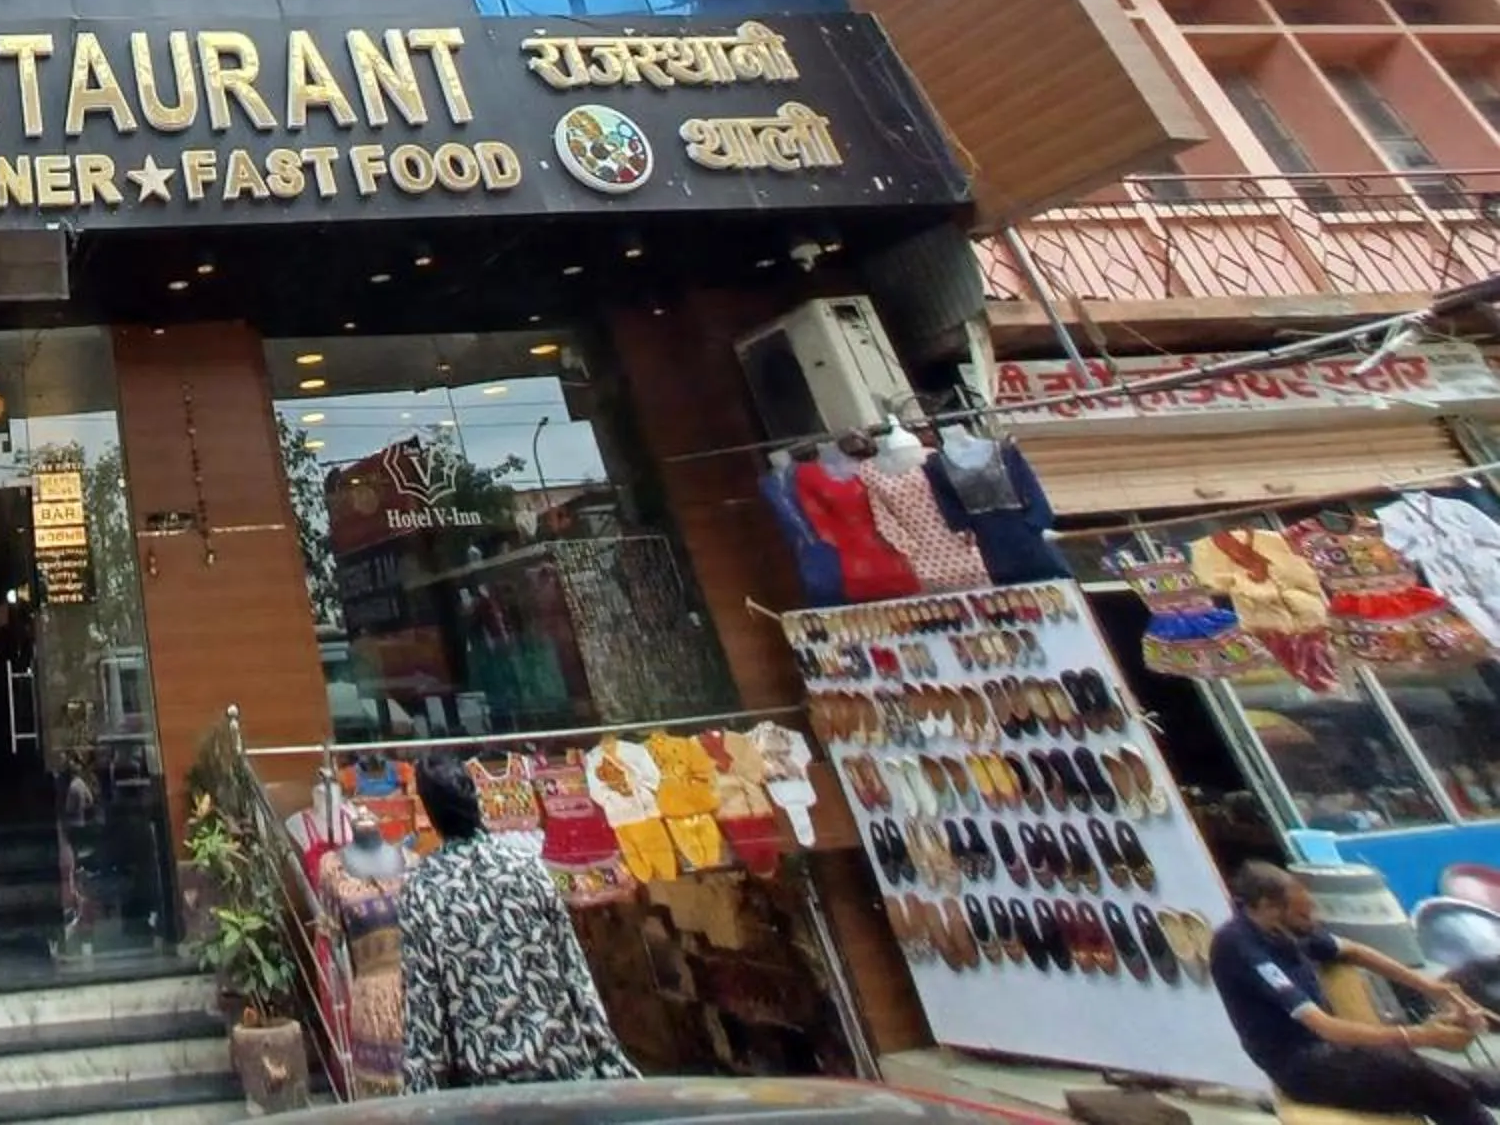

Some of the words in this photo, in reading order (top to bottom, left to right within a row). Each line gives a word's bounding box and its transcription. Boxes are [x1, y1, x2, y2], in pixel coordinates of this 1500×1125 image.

[520, 19, 800, 89] राजस्थानी
[678, 100, 844, 172] थाली
[181, 147, 340, 202] FAST
[349, 140, 523, 197] FOOD
[41, 506, 75, 520] BAR
[387, 508, 433, 528] Hotel
[436, 506, 482, 527] V-Inn
